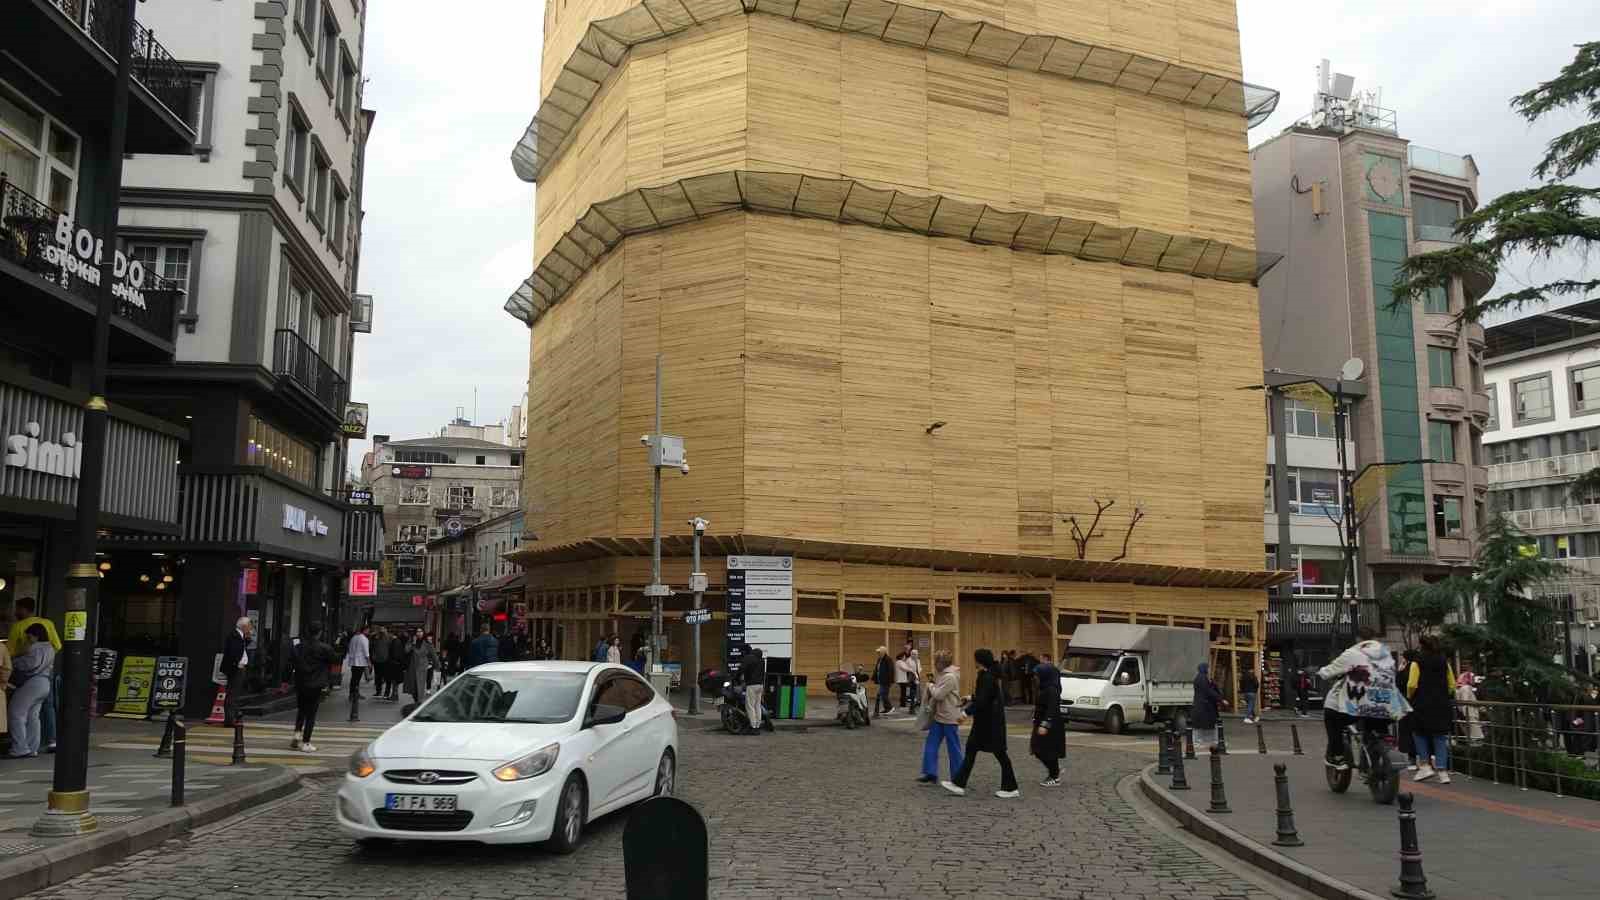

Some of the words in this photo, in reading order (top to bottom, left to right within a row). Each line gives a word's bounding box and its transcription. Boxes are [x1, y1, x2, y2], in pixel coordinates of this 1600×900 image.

[158, 669, 183, 677] OTO
[156, 692, 180, 700] PARK
[410, 796, 427, 809] FA
